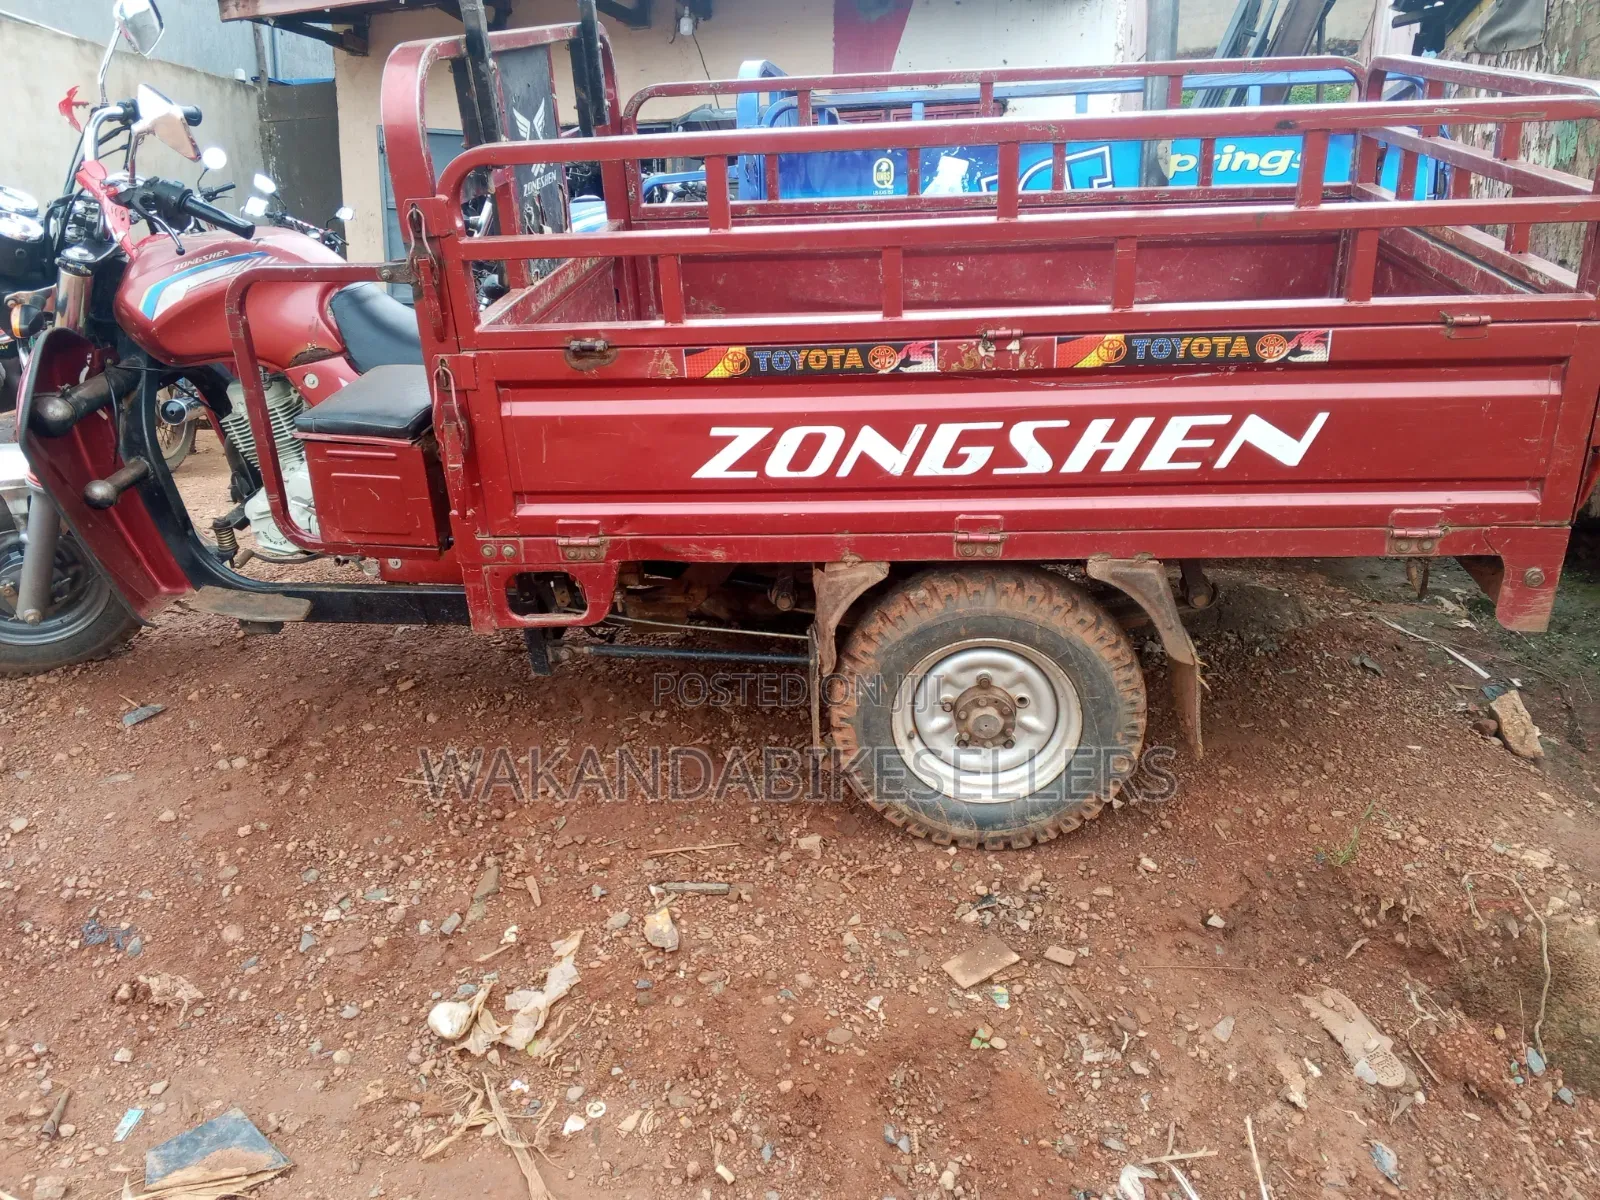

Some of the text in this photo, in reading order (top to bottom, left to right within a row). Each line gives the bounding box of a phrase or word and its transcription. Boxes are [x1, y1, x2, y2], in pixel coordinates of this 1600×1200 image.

[523, 169, 557, 198] ZONGSHEN
[753, 347, 865, 372] TOYOTA
[1131, 335, 1250, 360] TOYOTA
[691, 412, 1330, 480] ZONGSHEN
